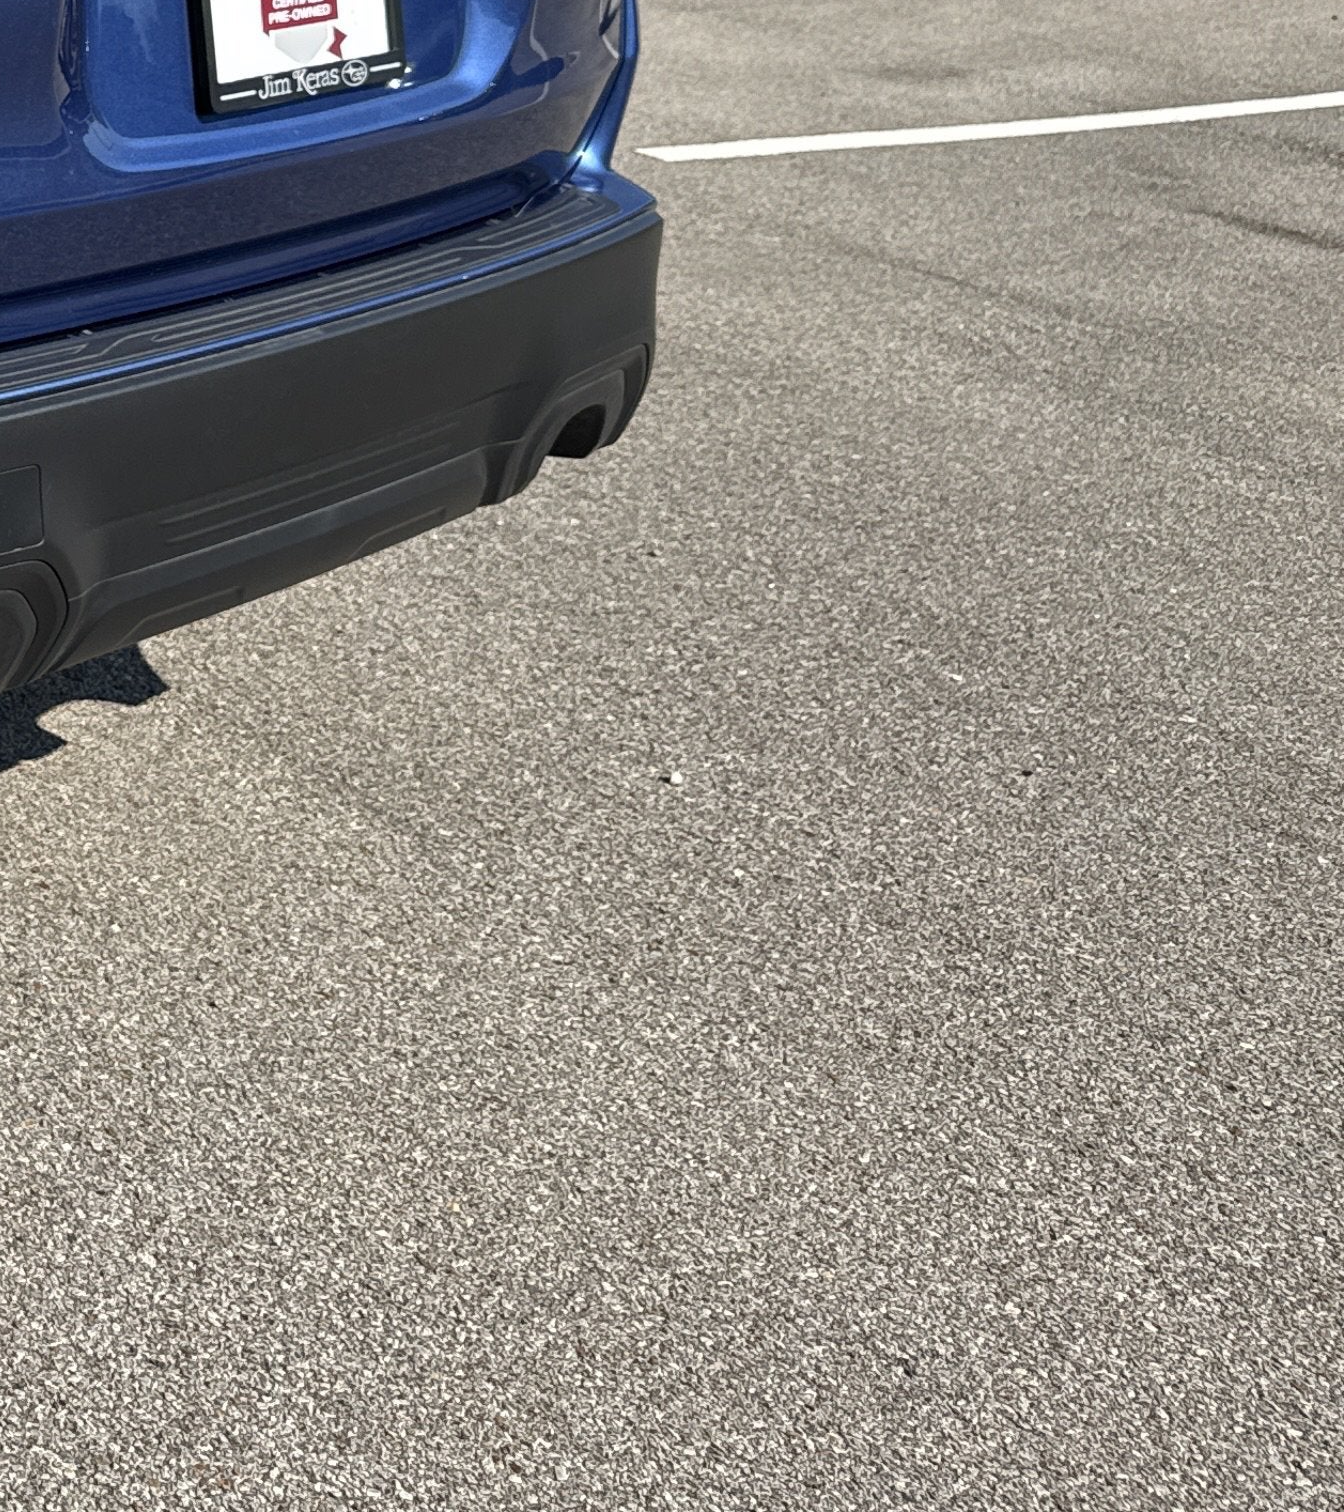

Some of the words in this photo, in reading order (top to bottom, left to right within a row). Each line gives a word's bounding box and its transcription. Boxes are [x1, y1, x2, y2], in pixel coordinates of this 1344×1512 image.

[268, 3, 332, 25] PRE-OWNED
[258, 75, 292, 99] Jim
[292, 68, 339, 96] Keras
